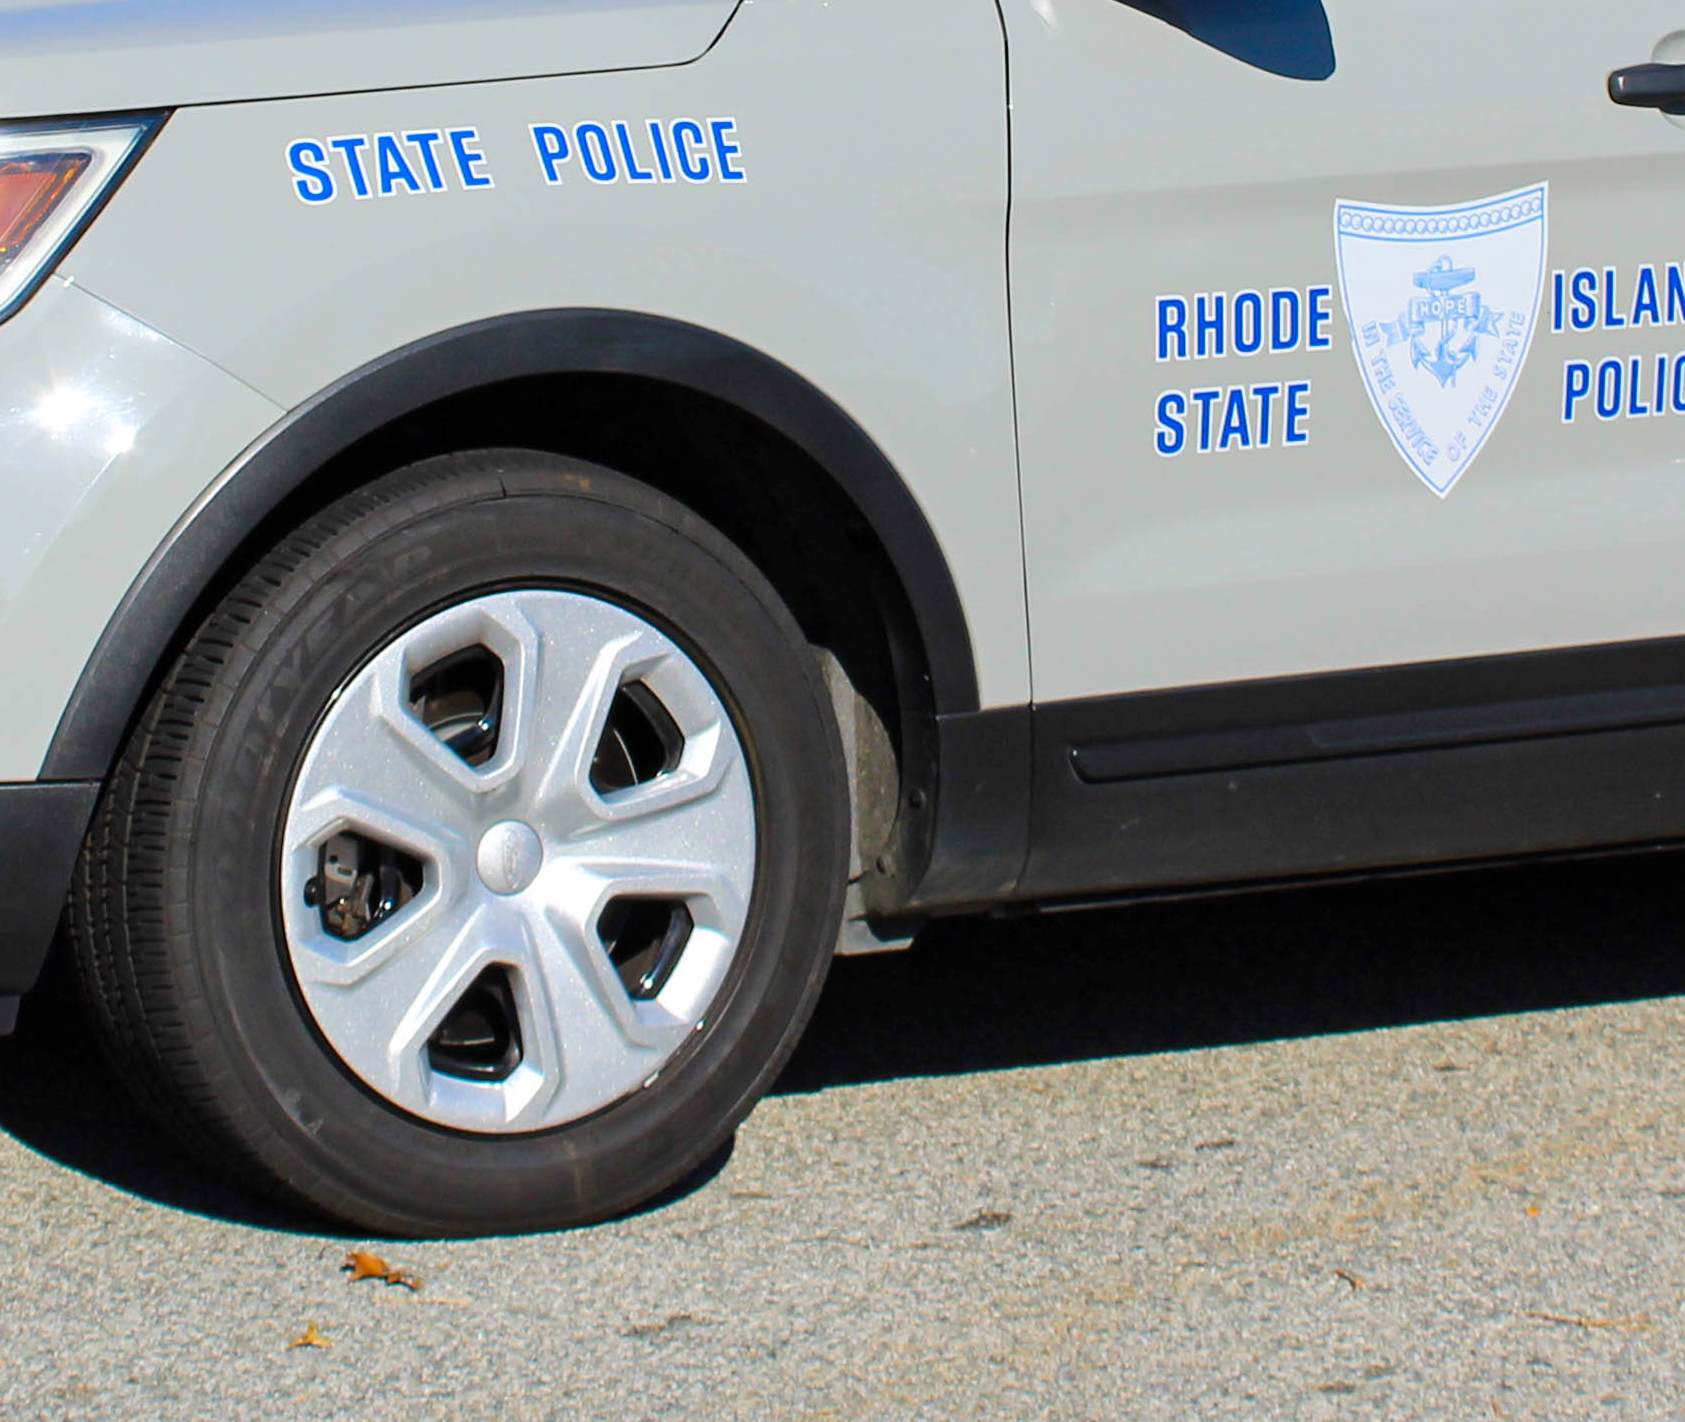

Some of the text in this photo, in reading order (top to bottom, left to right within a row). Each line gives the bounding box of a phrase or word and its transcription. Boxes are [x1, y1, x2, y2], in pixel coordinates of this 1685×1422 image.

[285, 116, 747, 206] STATE POLICE
[1154, 285, 1333, 362] RHODE
[1418, 297, 1466, 316] HOPE
[1153, 380, 1312, 456] STATE
[1372, 348, 1397, 395] THE
[1446, 430, 1468, 463] OF
[1493, 311, 1527, 381] STATE
